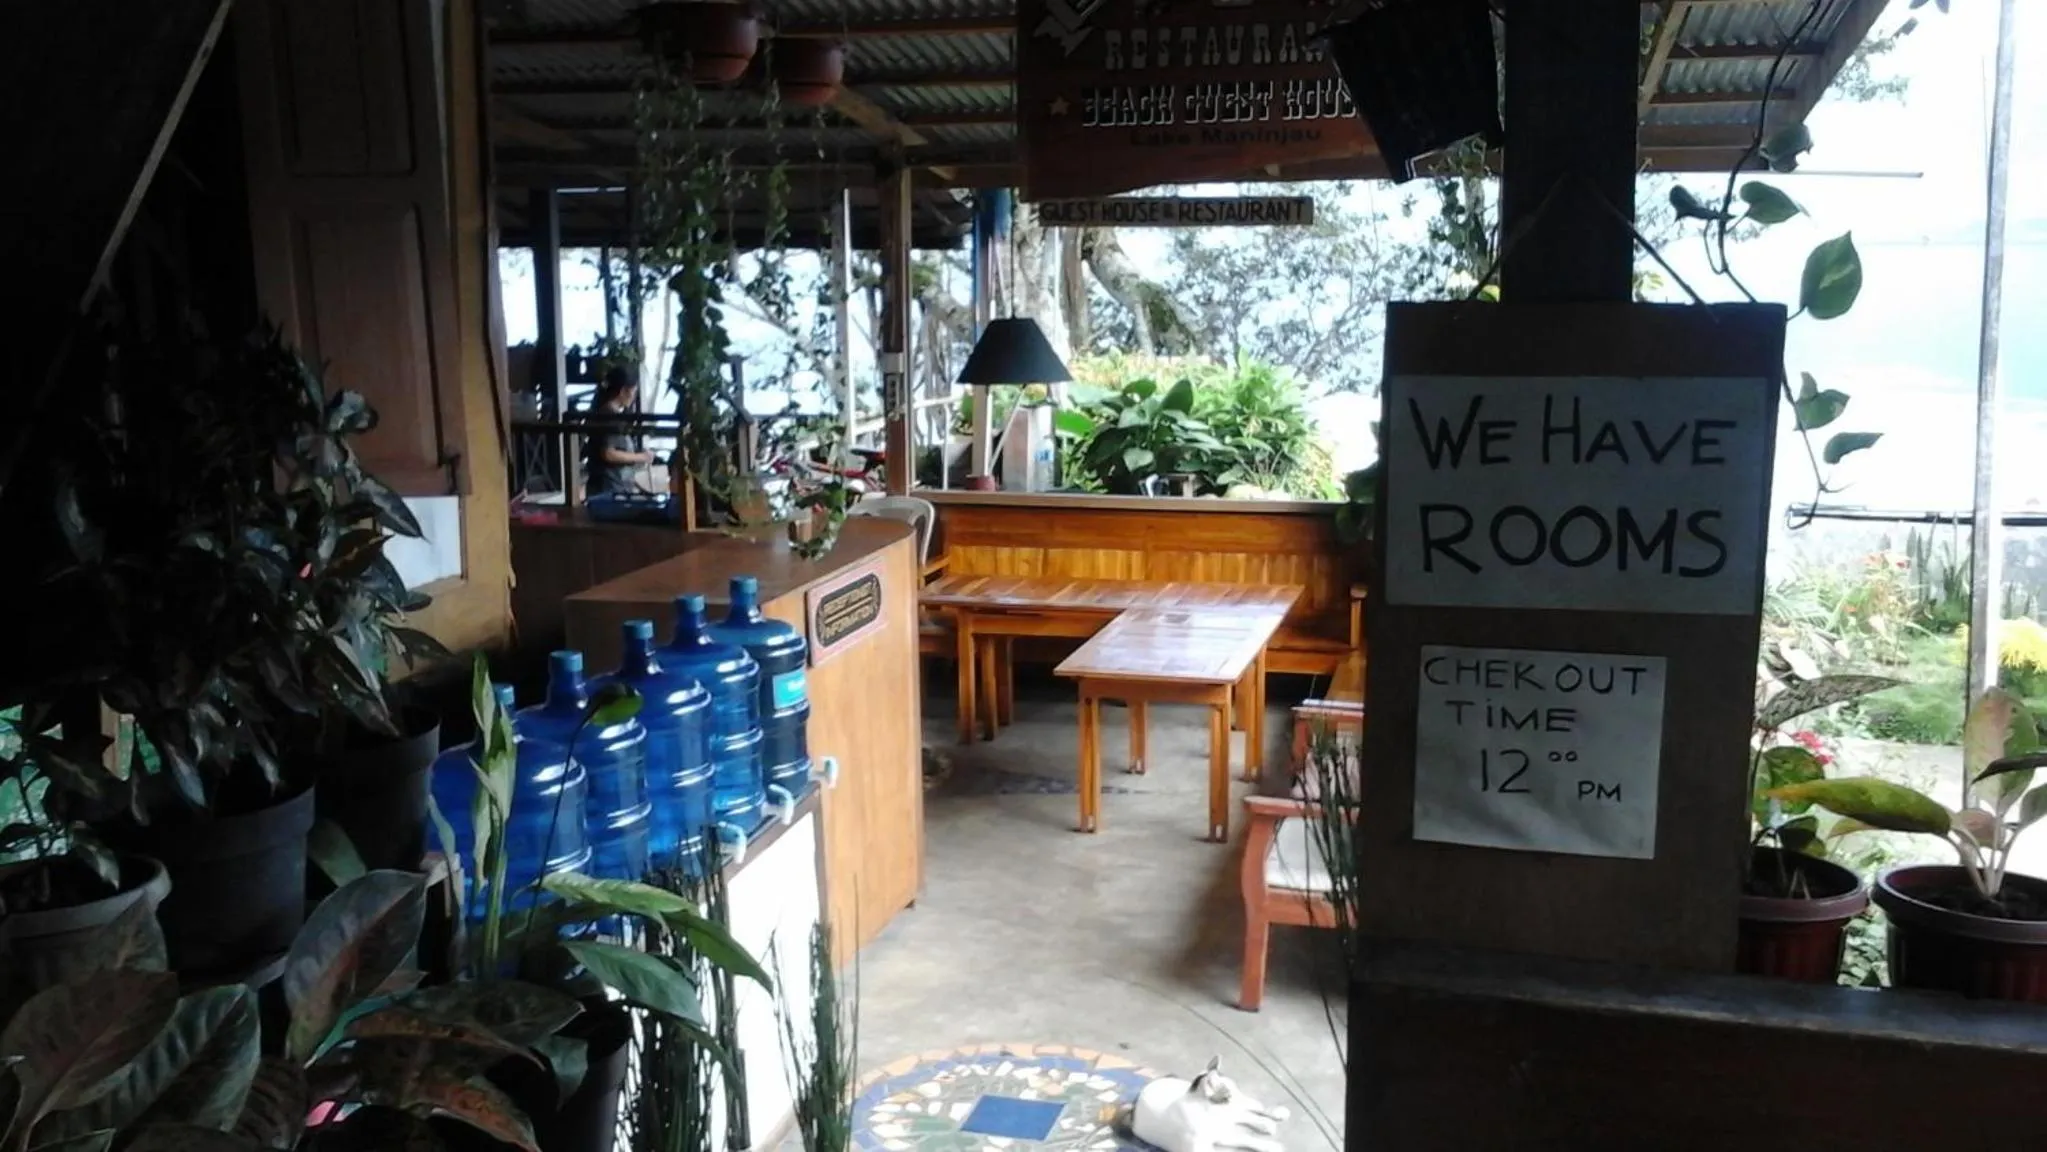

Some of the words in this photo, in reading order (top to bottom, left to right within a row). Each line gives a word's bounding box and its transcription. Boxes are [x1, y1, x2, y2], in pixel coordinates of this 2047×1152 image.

[1081, 84, 1175, 127] BEACH
[1184, 80, 1274, 124] GUEST
[1202, 127, 1322, 146] Maninjau
[1040, 201, 1094, 222] GUEST
[1102, 202, 1159, 222] HOUSE
[1178, 200, 1305, 223] RESTAURANT
[1408, 395, 1517, 470] WE
[1542, 394, 1737, 465] HAVE
[1419, 503, 1728, 578] ROOMS
[1423, 656, 1545, 692] CHEK
[1555, 664, 1647, 695] OUT
[1577, 780, 1623, 802] PM
